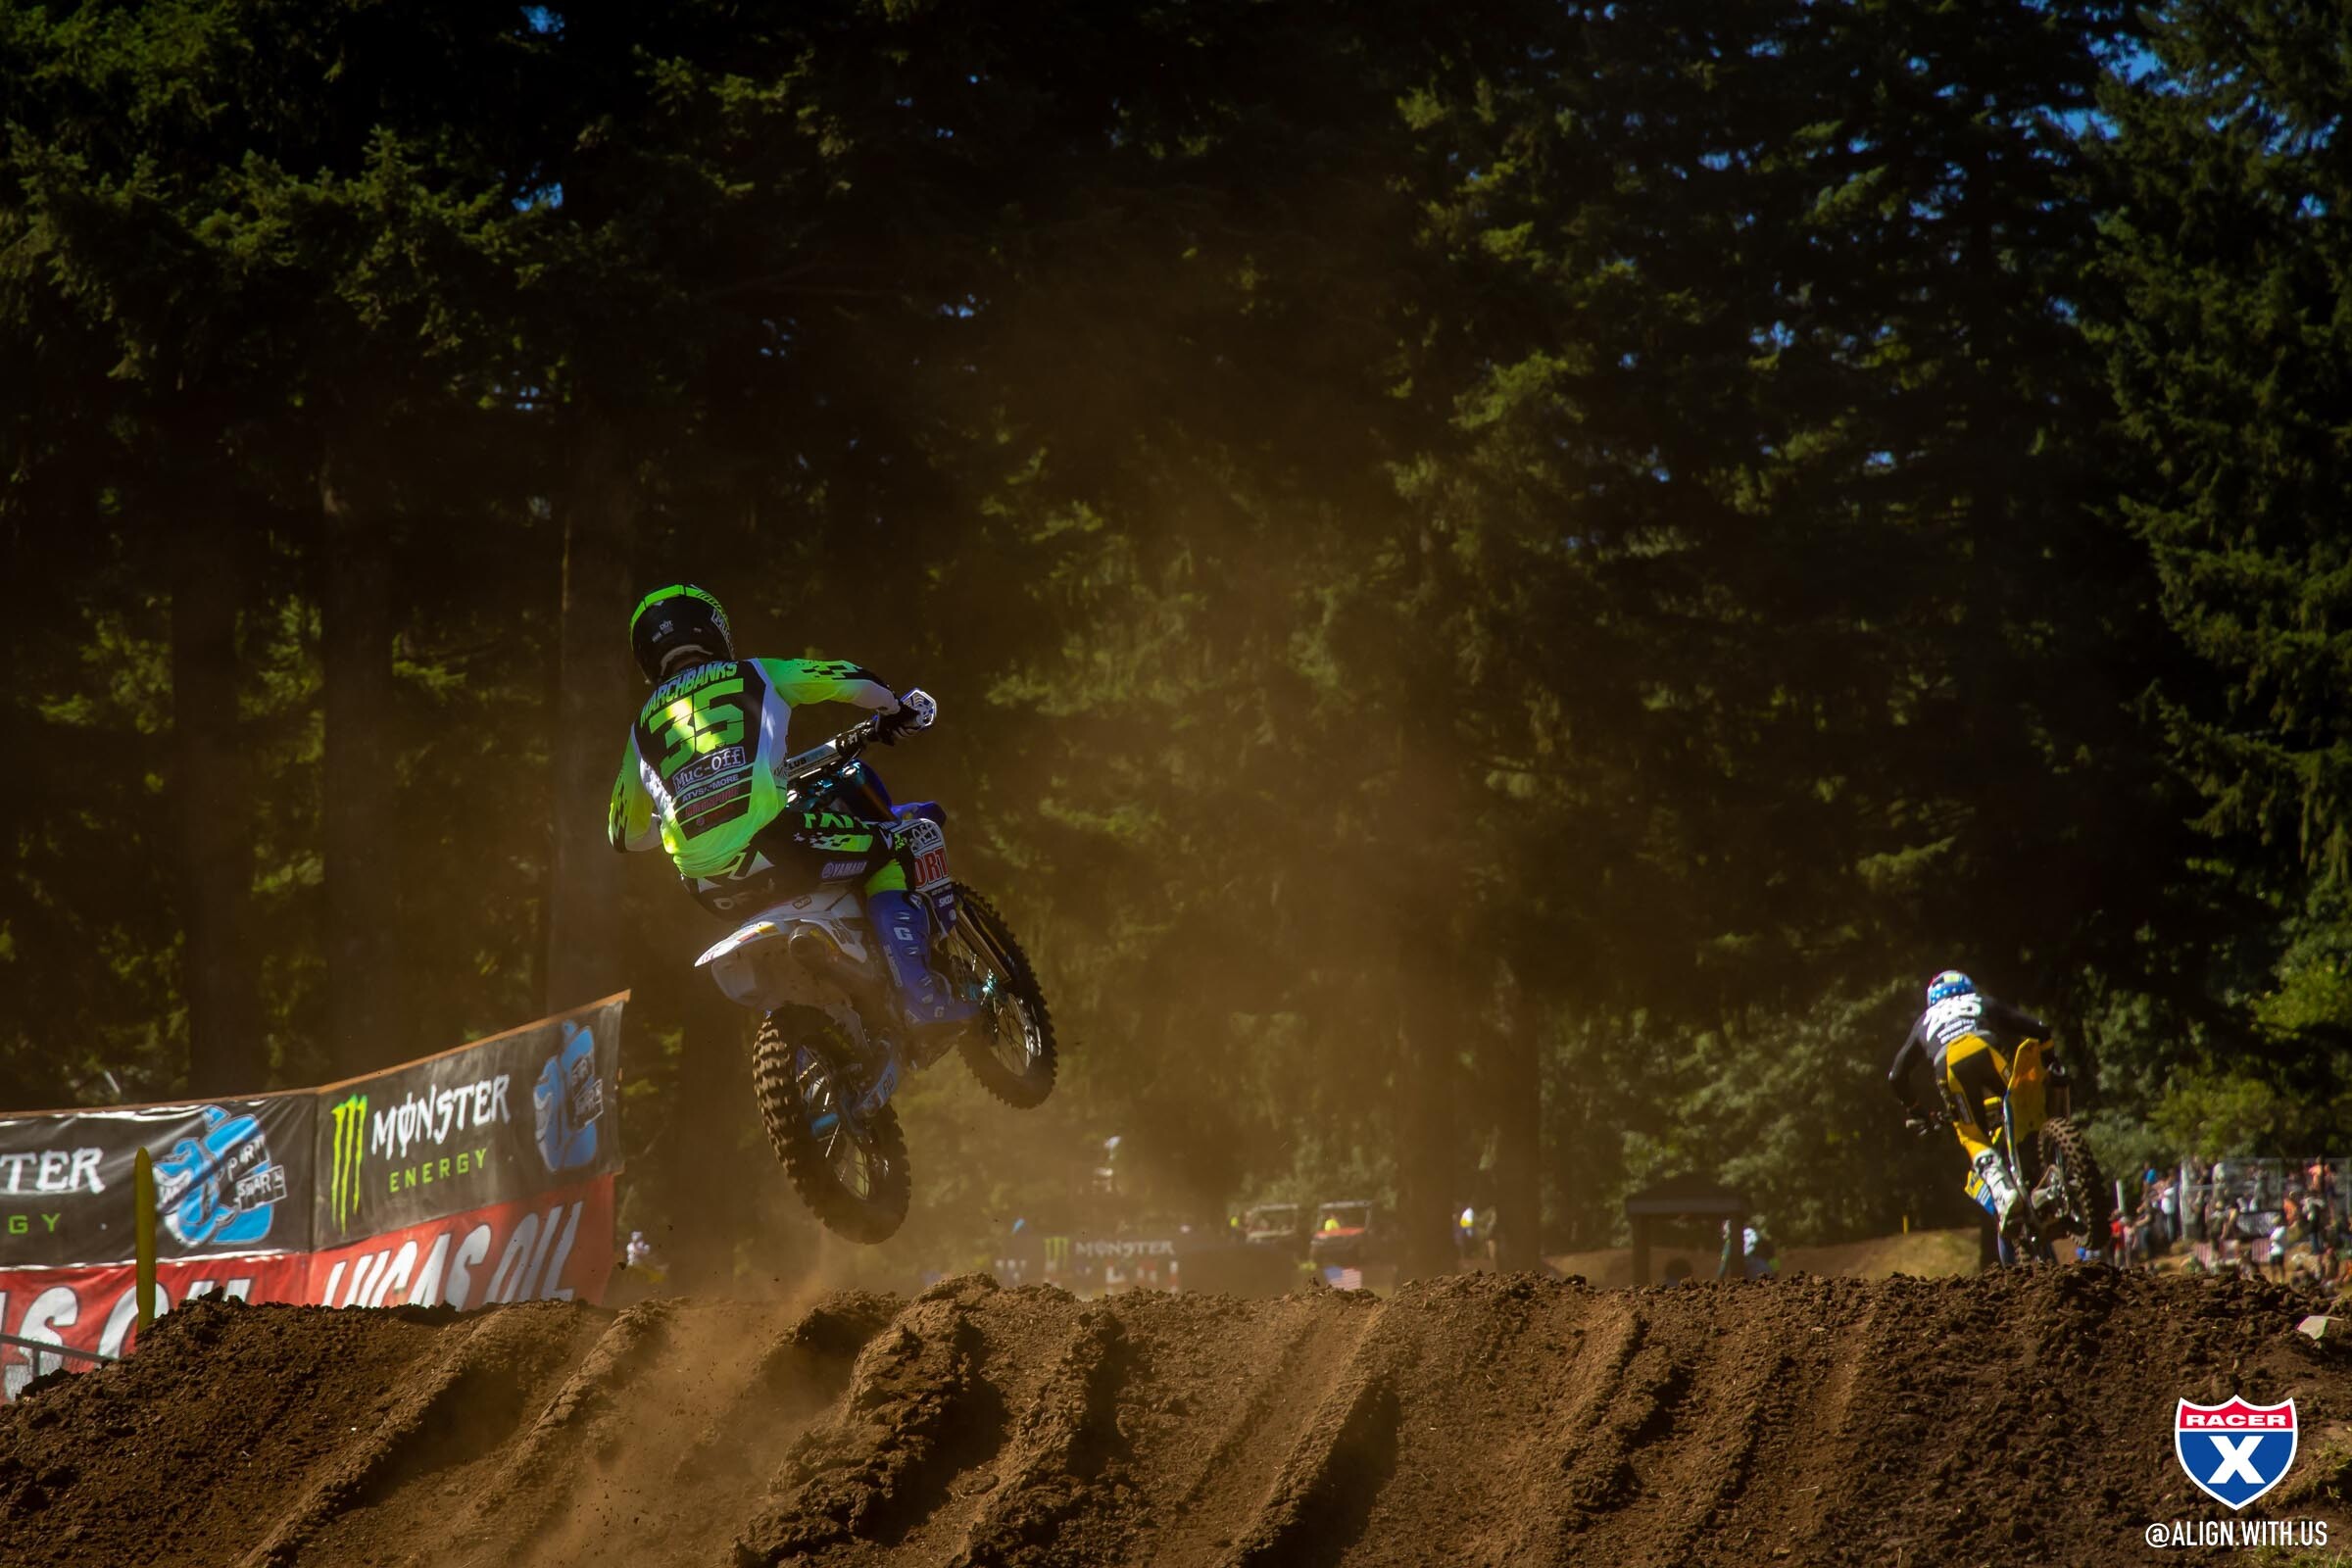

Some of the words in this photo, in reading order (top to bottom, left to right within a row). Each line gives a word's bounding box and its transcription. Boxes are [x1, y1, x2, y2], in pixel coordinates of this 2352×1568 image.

[640, 661, 739, 728] MARCHBANKS
[649, 678, 744, 779] 35
[711, 774, 739, 789] MORE
[371, 1074, 511, 1160] MONSTER
[389, 1148, 487, 1193] ENERGY
[9, 1213, 61, 1234] GY
